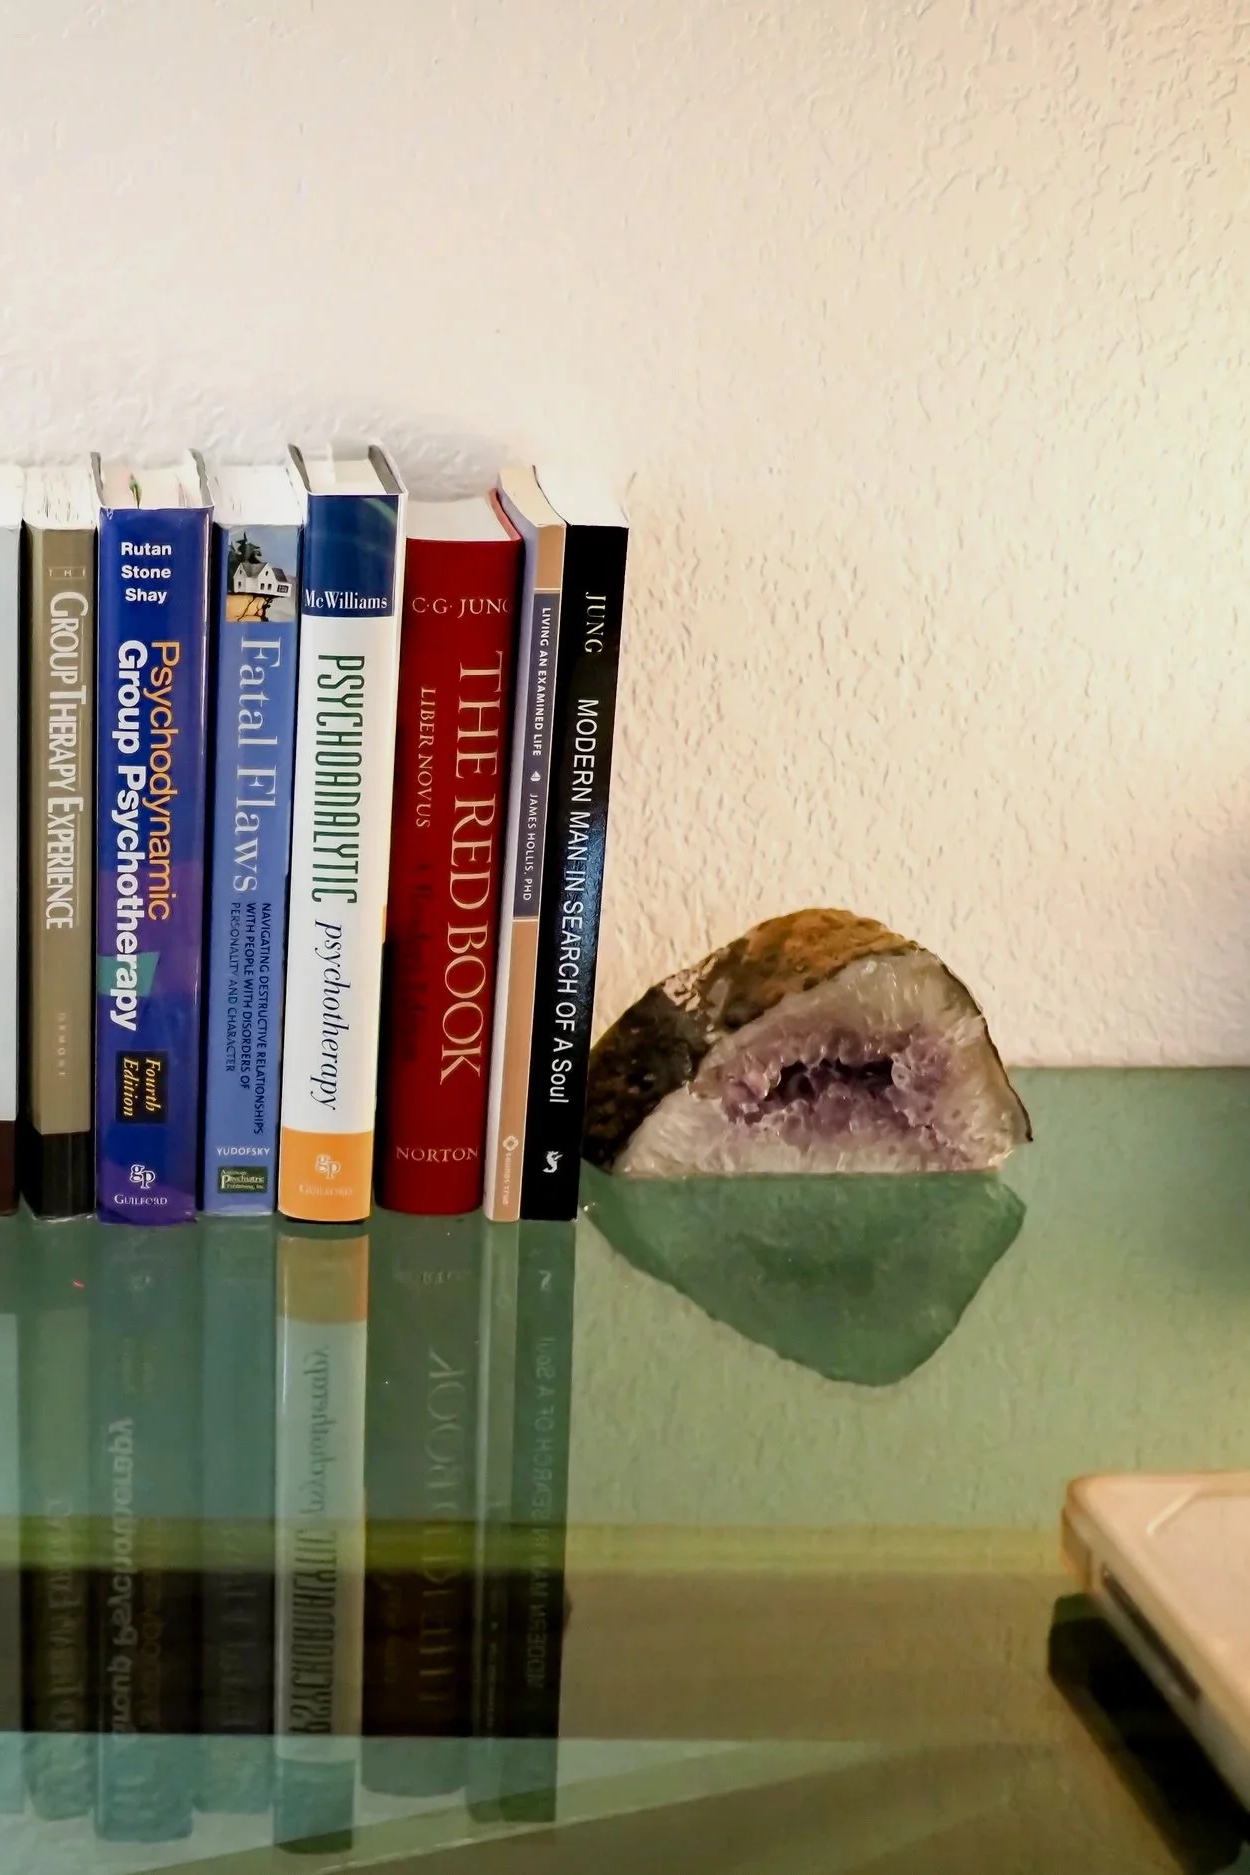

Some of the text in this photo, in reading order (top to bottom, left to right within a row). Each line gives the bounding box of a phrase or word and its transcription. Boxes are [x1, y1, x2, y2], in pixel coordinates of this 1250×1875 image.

[121, 542, 172, 556] Rutan
[121, 565, 172, 579] Stone
[125, 588, 167, 604] Shay
[305, 589, 388, 609] McWilliams
[533, 607, 551, 756] LIVING AN EXAMINED LIFE
[584, 592, 606, 653] JUNG
[142, 641, 180, 920] Psychodynamic
[233, 636, 281, 892] Fatal Flaws
[416, 687, 436, 828] LIBER NOVUS
[110, 640, 148, 1031] Group Psychotherapy
[310, 655, 365, 1110] PSYCHOANALYTIC psychotherapy
[439, 650, 503, 1086] THE RED BOOK
[523, 794, 538, 900] JAMES HOLLIS, PHD
[549, 699, 599, 1104] MODERN MAN IN SEARCH OF A Soul
[225, 903, 241, 1072] PERSONALITY AND CHARACTER
[240, 902, 256, 1090] WITH PEOPLE WITH DISORDERS OF
[253, 903, 271, 1135] NAVIGATING DESTRUCTIVE RELATIONSHIPS
[123, 1057, 139, 1117] Edition
[145, 1058, 161, 1112] Fourth
[216, 1148, 271, 1157] YUDOFSKY
[396, 1146, 478, 1163] NORTON
